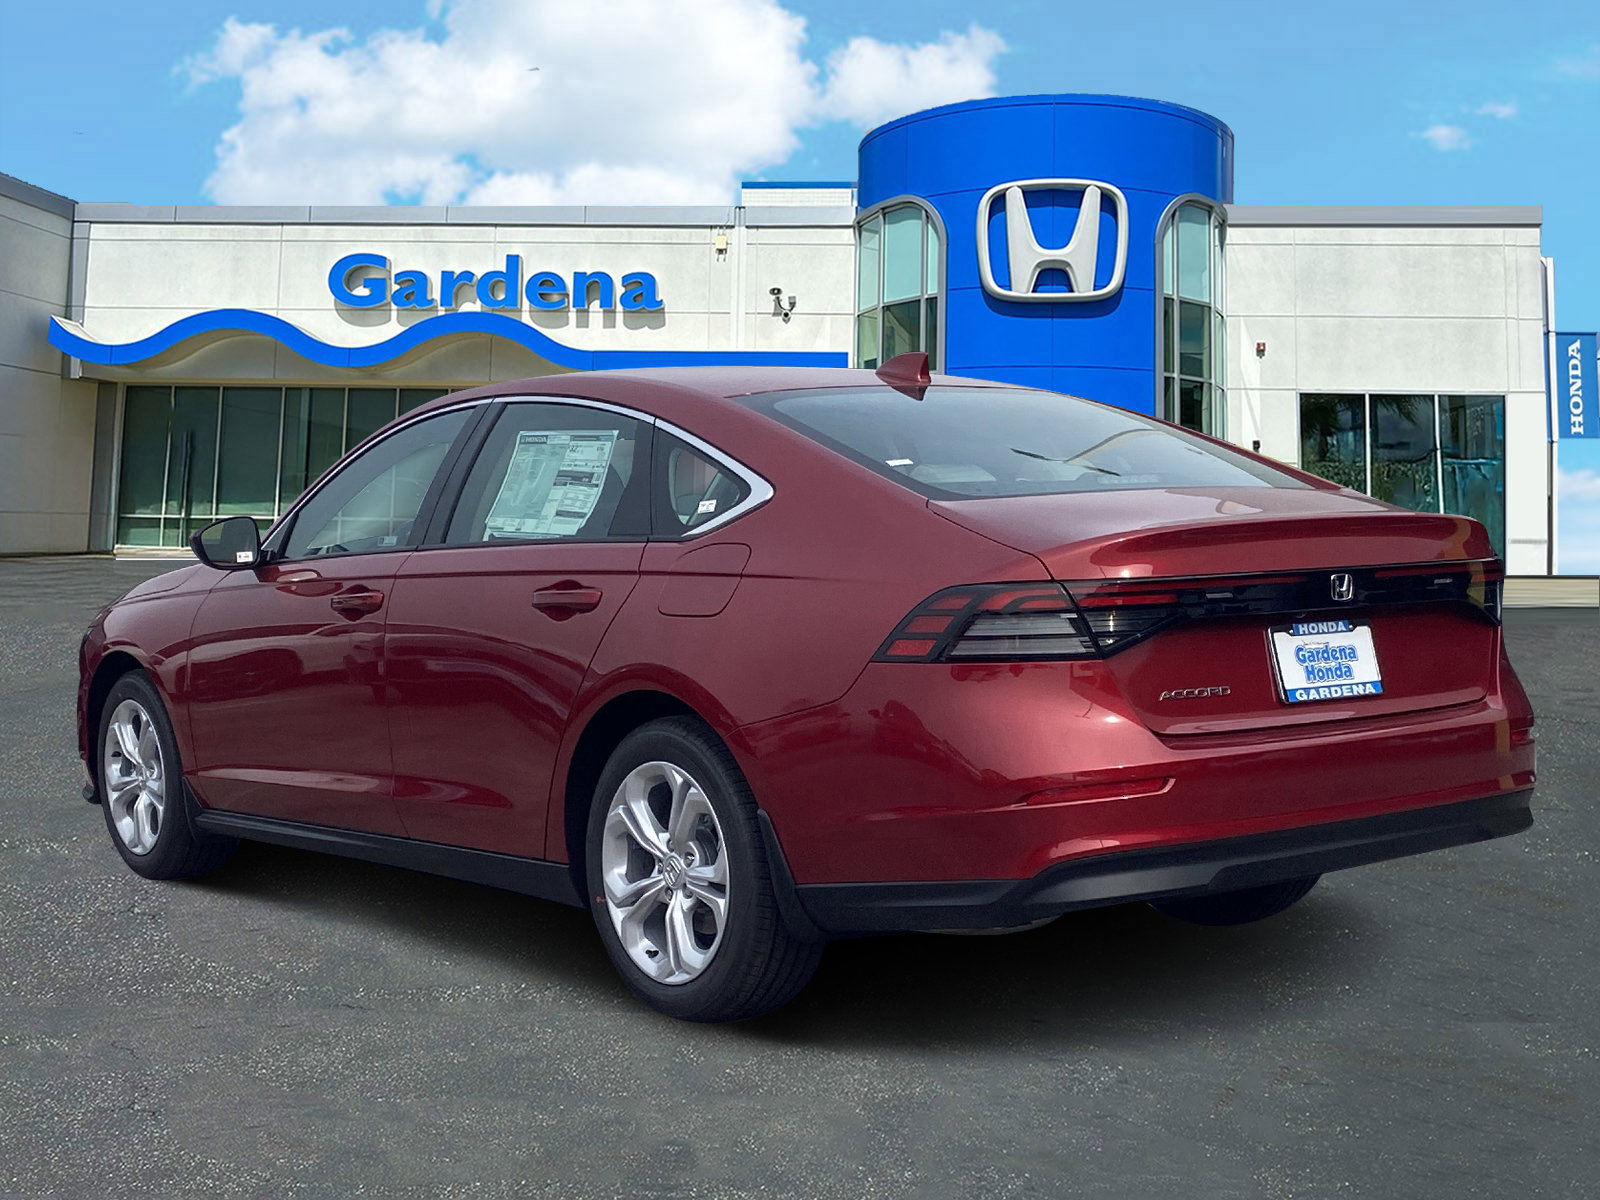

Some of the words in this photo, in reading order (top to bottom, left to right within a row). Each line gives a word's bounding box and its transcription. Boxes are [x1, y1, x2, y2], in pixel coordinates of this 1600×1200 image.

[328, 253, 664, 309] Gardena
[1568, 339, 1584, 435] HONDA
[1299, 621, 1346, 634] HONDA
[1295, 644, 1358, 665] Gardena
[1304, 661, 1354, 683] Honda
[1159, 686, 1231, 701] ACCORD
[1295, 683, 1376, 701] GARDENA
